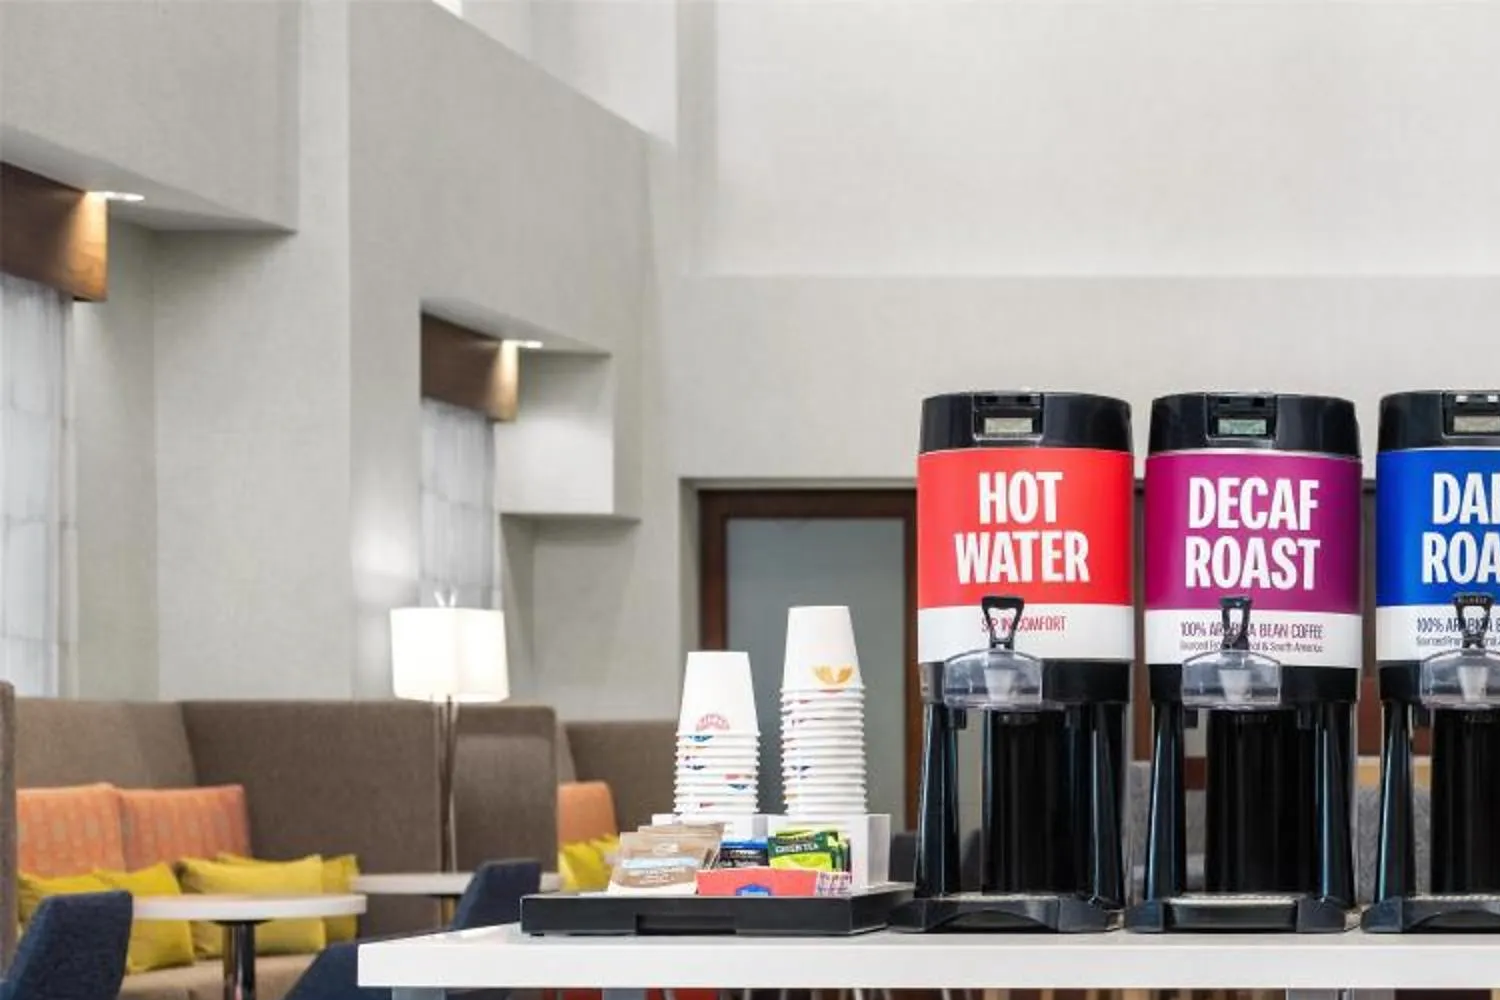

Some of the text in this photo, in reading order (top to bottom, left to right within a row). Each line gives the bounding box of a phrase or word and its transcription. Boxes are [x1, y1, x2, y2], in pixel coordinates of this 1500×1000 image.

[980, 471, 1062, 523] HOT
[1190, 478, 1318, 530] DECAF
[955, 531, 1088, 583] WATER
[1186, 536, 1320, 589] ROAST
[1180, 622, 1206, 637] 100%
[1260, 623, 1288, 639] BEAN
[1291, 624, 1324, 639] COFFEE
[1417, 617, 1444, 633] 100%
